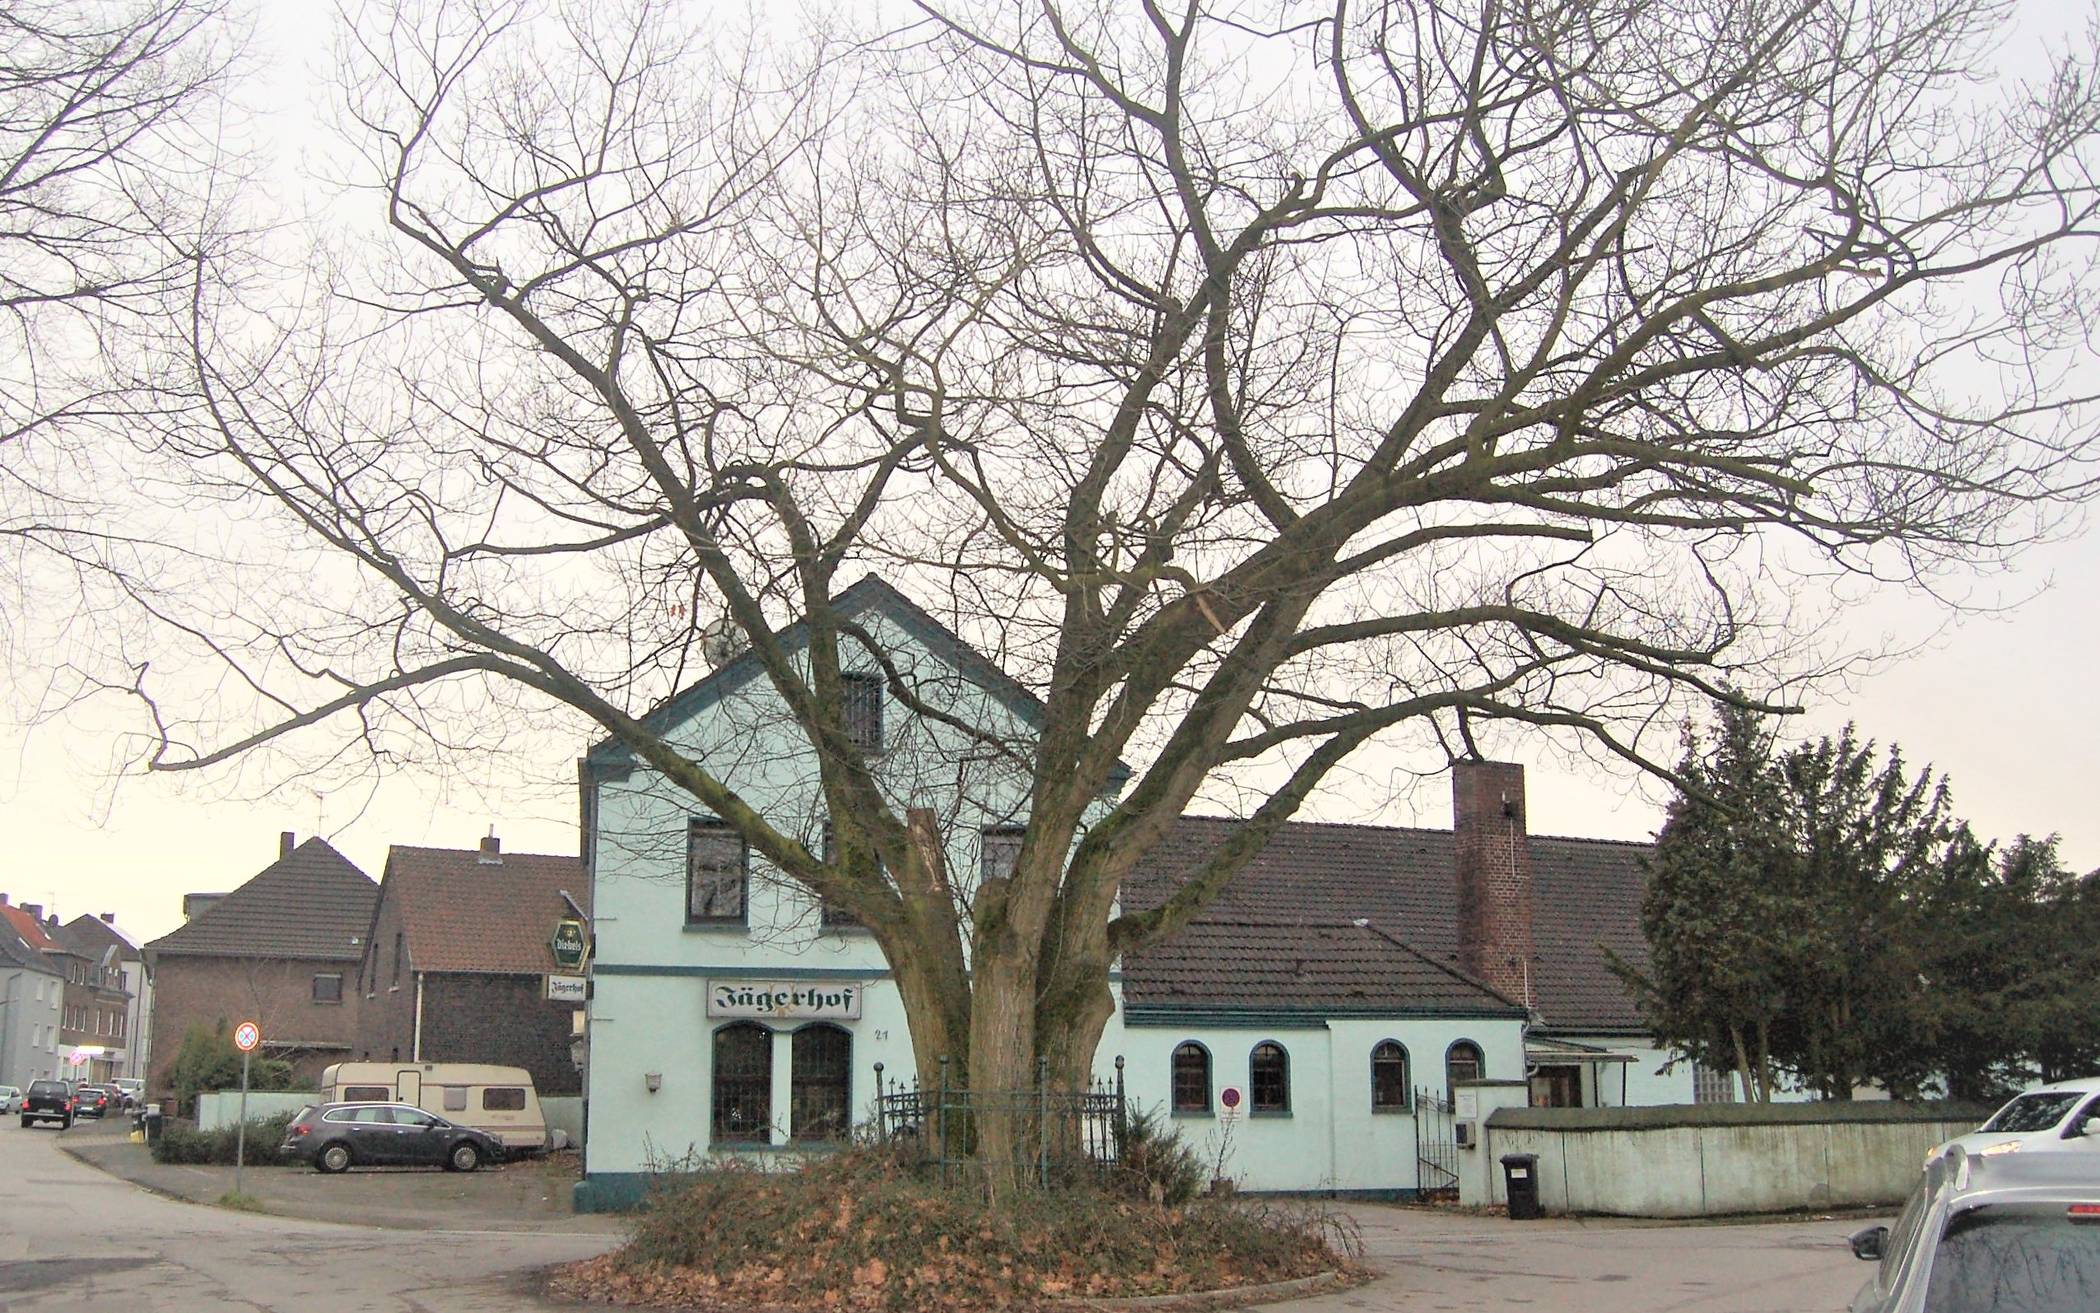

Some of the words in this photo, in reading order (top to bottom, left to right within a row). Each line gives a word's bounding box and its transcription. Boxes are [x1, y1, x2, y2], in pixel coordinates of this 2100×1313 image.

[556, 938, 582, 951] Diebels
[551, 981, 584, 994] Jägerhof
[715, 985, 853, 1013] Jägerhof
[874, 1029, 889, 1041] 21
